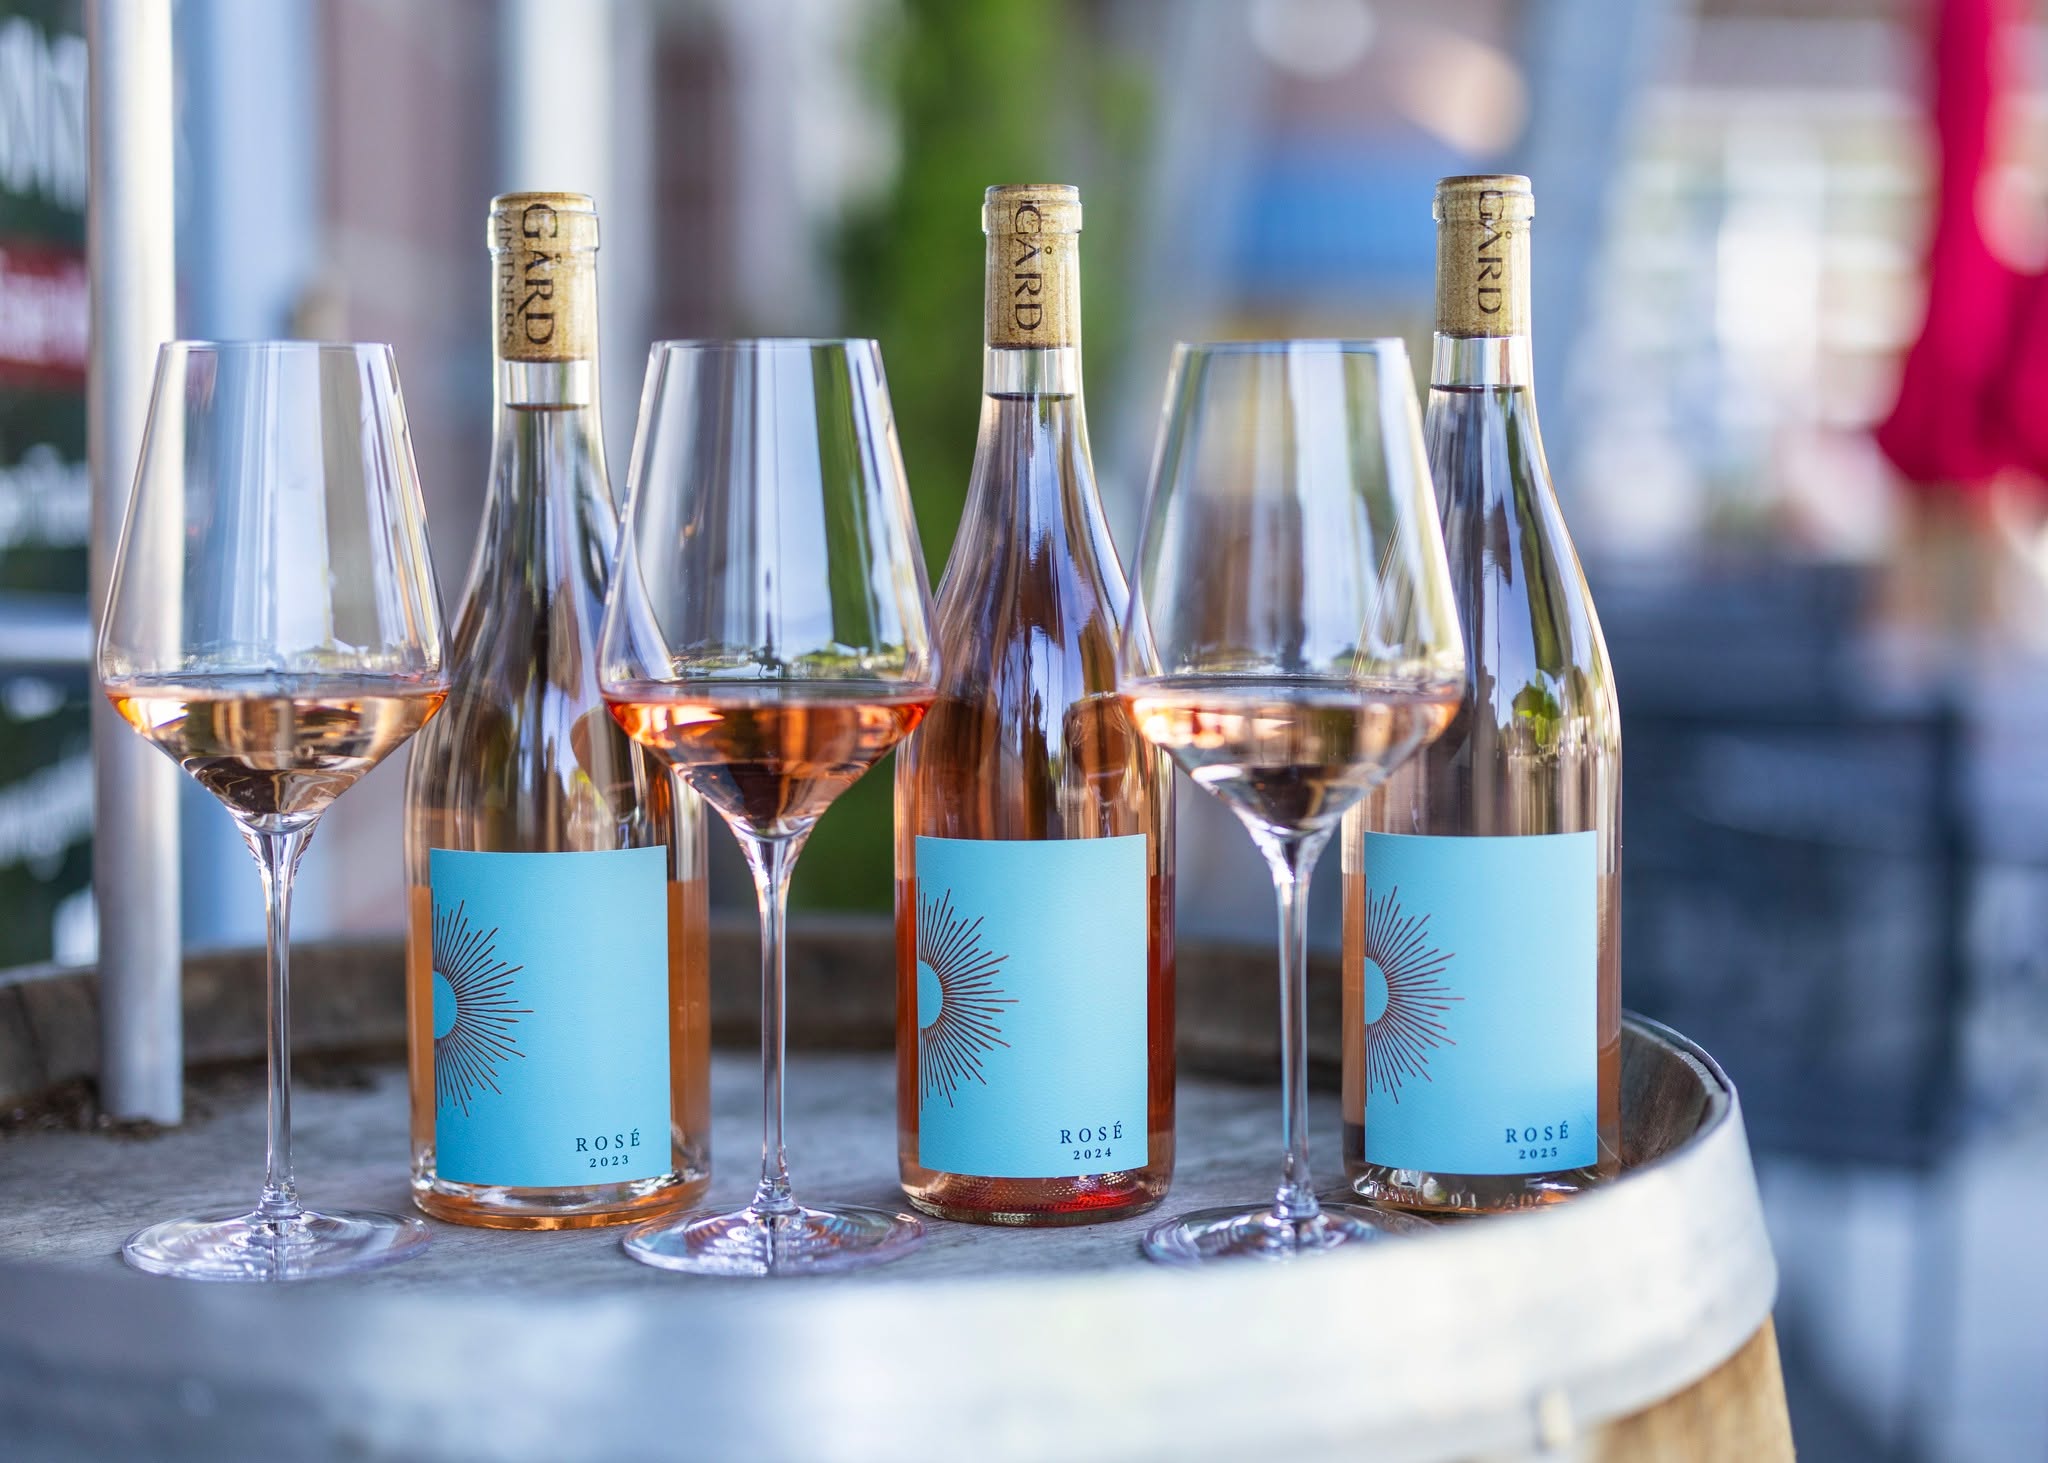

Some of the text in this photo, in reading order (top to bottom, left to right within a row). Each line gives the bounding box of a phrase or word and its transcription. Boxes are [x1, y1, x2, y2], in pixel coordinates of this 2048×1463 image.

[1477, 190, 1512, 315] GÅRD
[518, 203, 562, 345] GÅRD
[1015, 202, 1053, 331] GÅRD
[575, 1128, 640, 1152] ROSÉ
[1060, 1120, 1123, 1144] ROSÉ
[1505, 1120, 1569, 1144] ROSÉ
[589, 1154, 629, 1168] 2023
[1073, 1147, 1112, 1160] 2024
[1519, 1147, 1558, 1160] 2025
